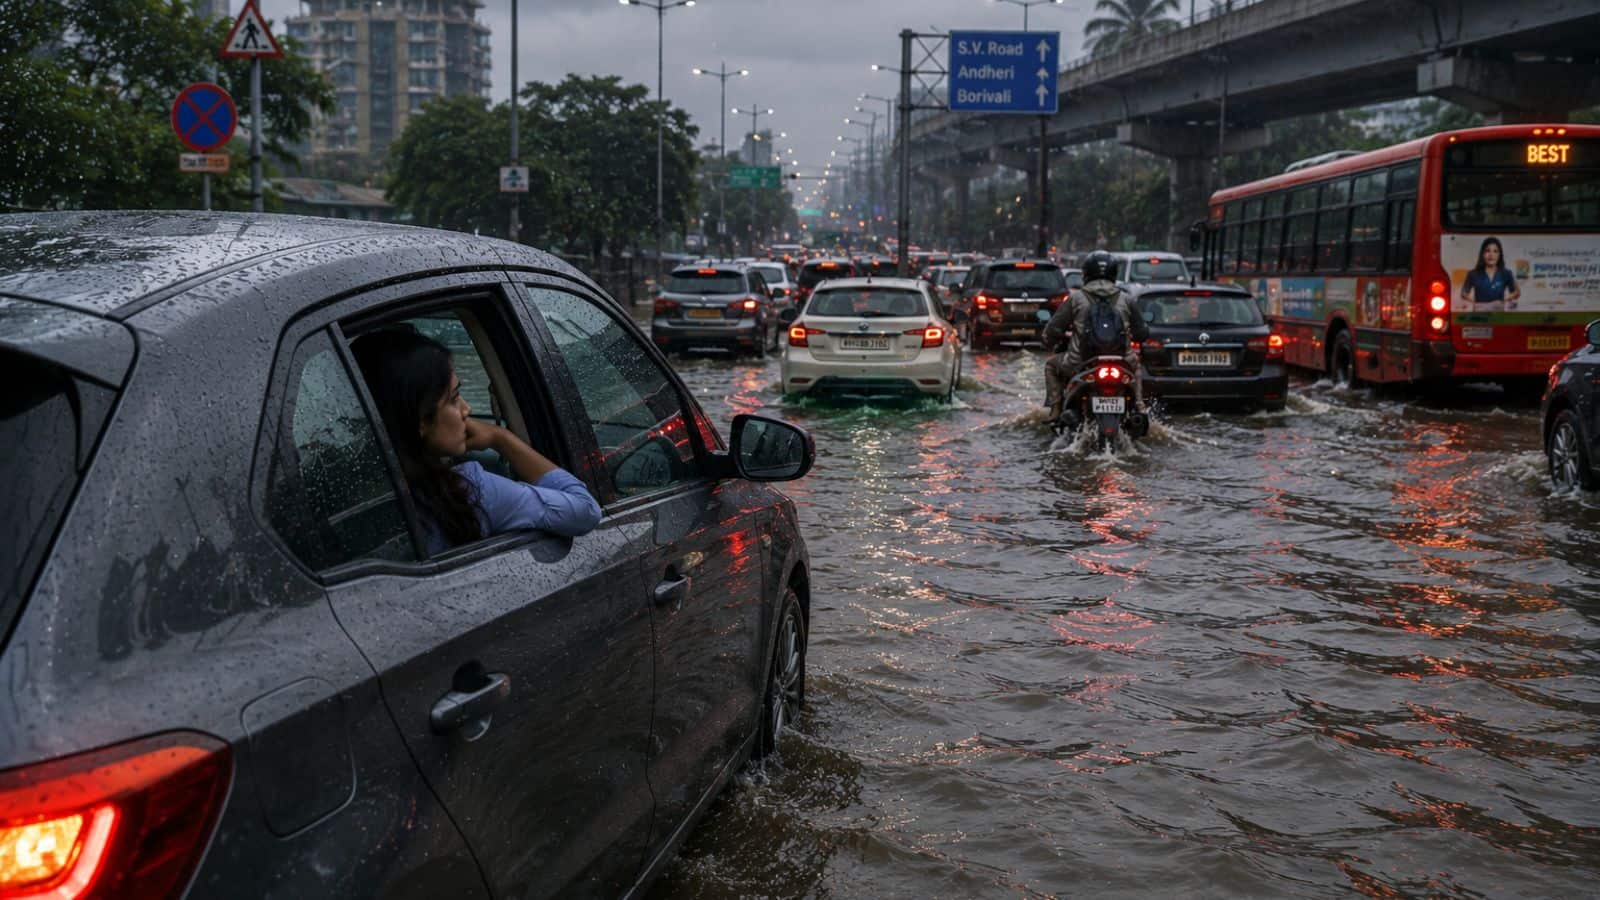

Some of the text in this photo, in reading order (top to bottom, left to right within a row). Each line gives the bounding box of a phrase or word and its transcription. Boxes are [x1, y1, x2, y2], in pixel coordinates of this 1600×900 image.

[957, 41, 1024, 56] S.V. Road
[957, 65, 1015, 80] Andheri
[957, 88, 1012, 103] Borivali
[1527, 144, 1570, 163] BEST
